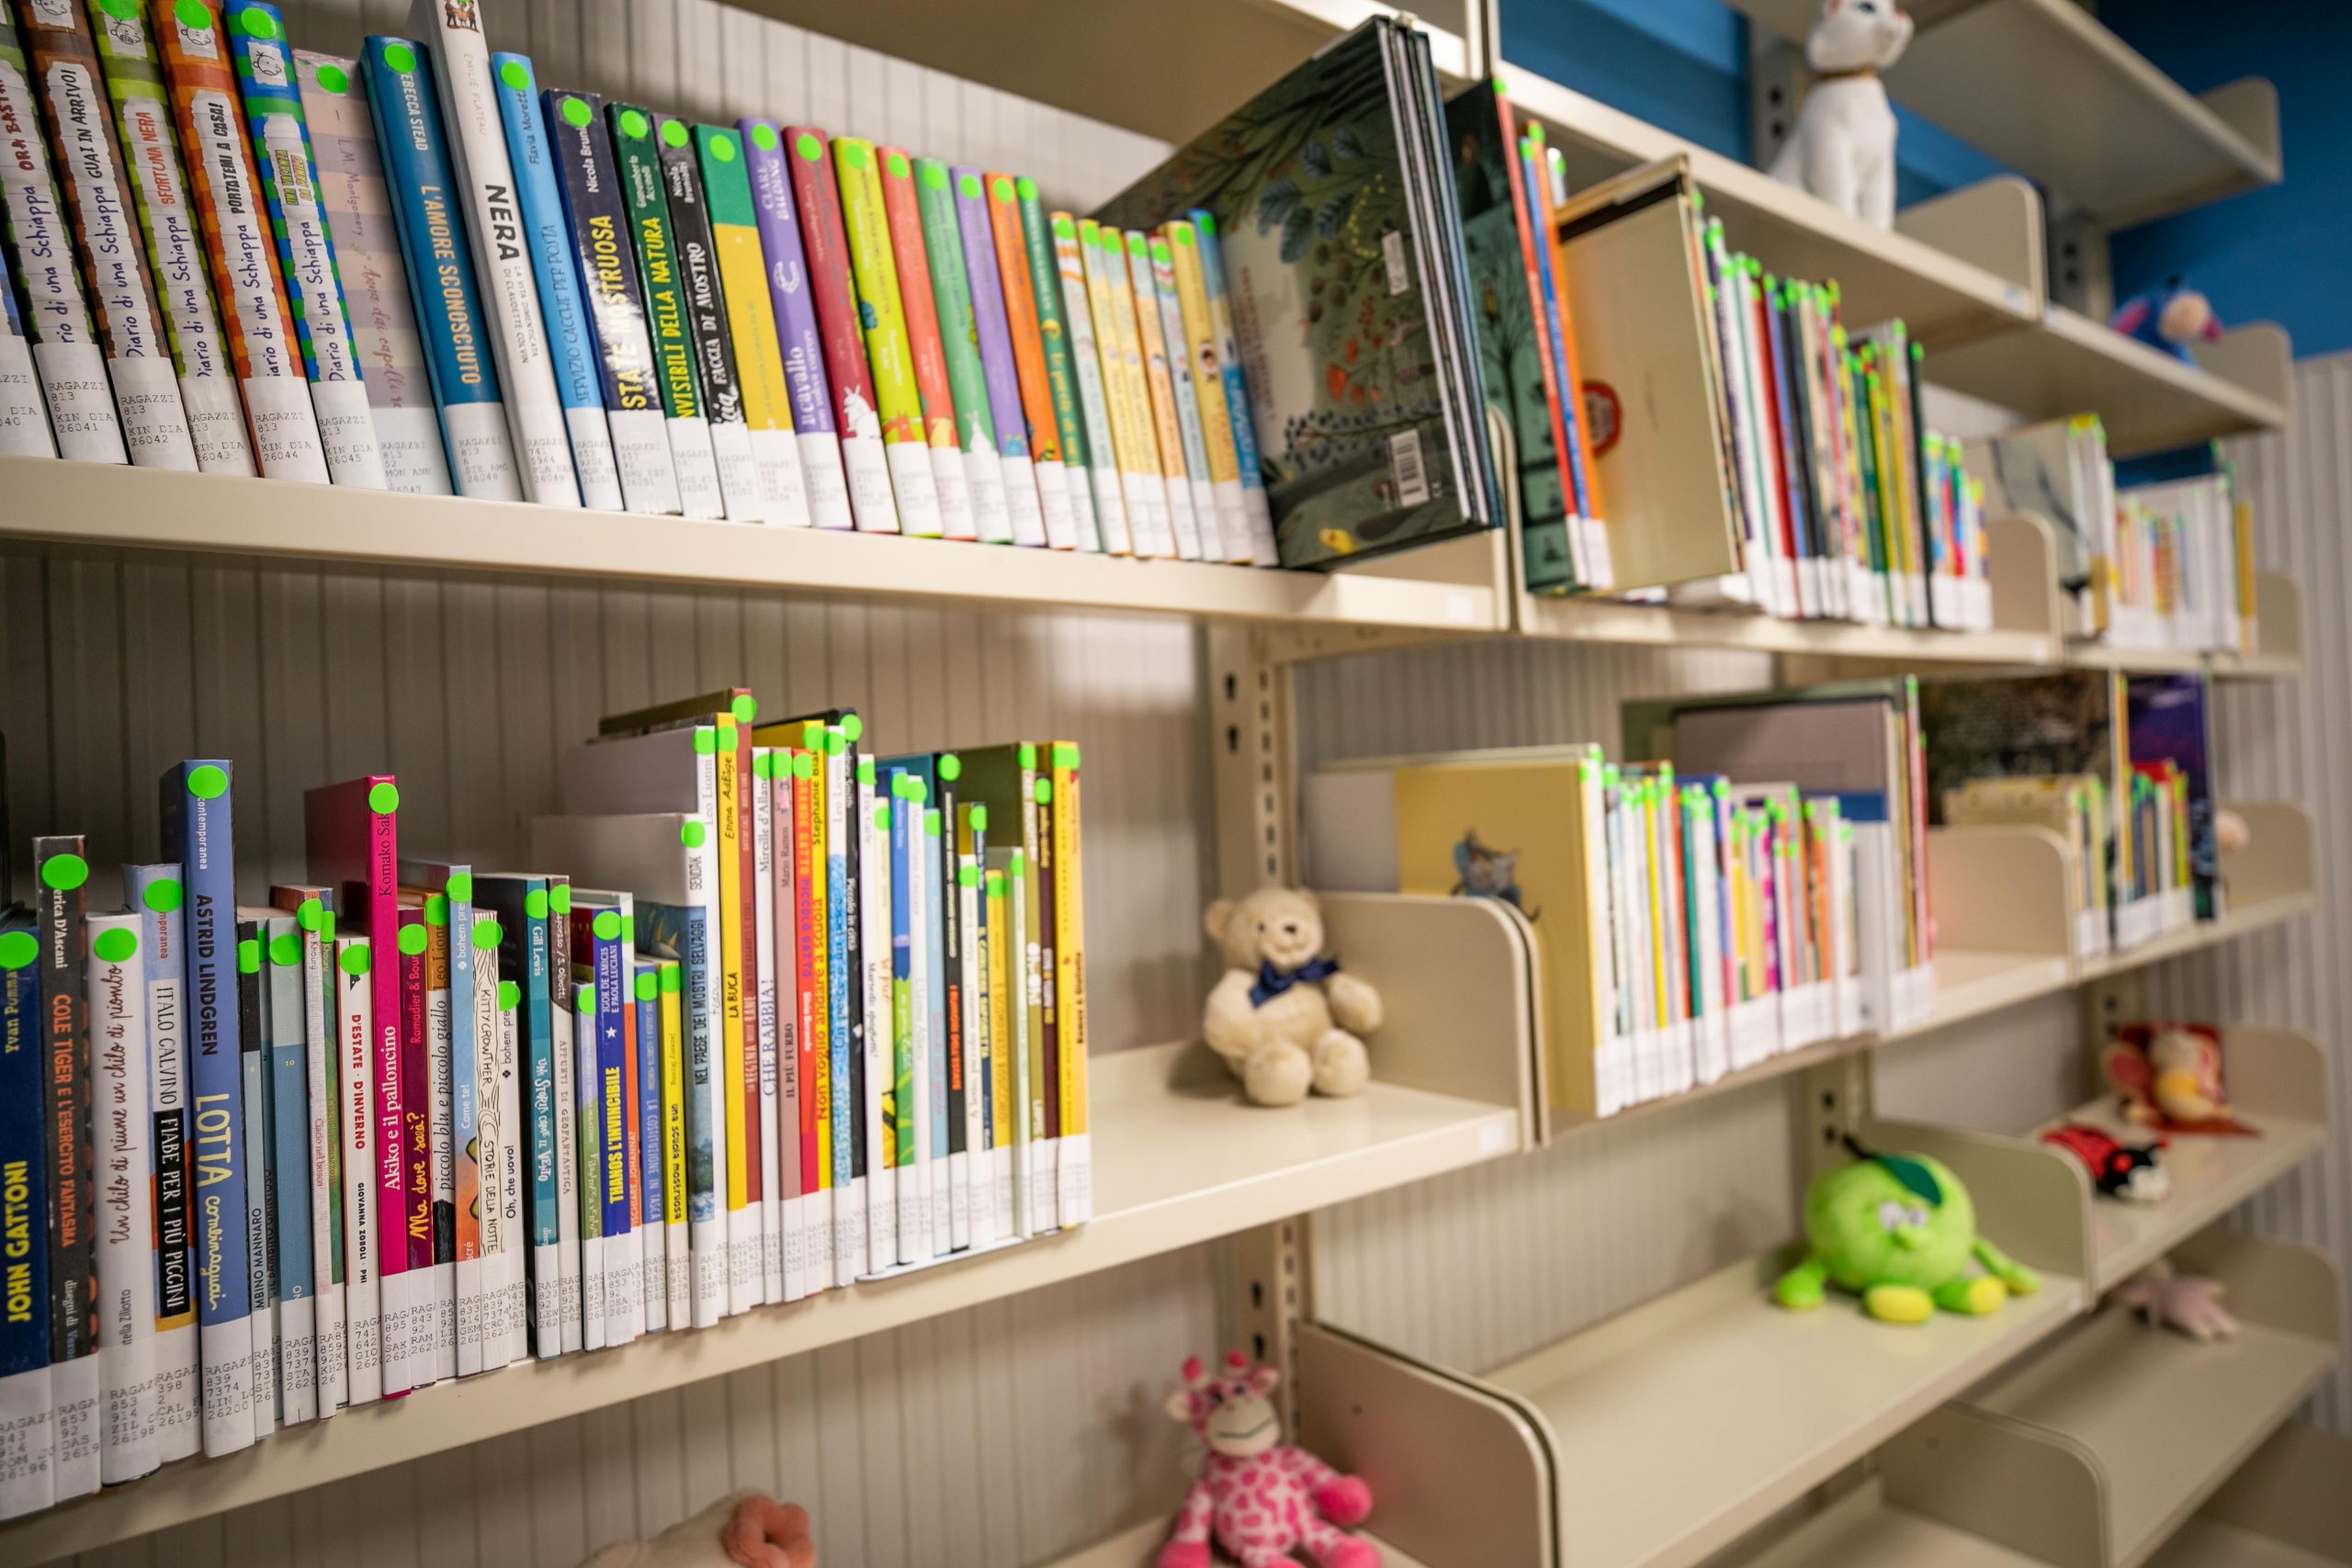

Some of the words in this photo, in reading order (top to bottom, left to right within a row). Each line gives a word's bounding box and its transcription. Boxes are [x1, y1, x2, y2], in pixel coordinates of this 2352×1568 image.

[61, 69, 87, 125] ARRIVO!
[401, 73, 420, 116] EBECCA
[411, 118, 428, 152] STEAD
[76, 129, 93, 143] IN
[136, 111, 158, 142] NERA
[209, 103, 229, 137] CASA!
[11, 139, 35, 171] ORA
[85, 147, 103, 179] GUAI
[217, 142, 231, 151] A
[526, 134, 539, 164] Flavia
[147, 146, 175, 206] SFORTUNA
[219, 153, 245, 214] PORTATEMI
[275, 150, 294, 186] VACANZA
[290, 154, 309, 188] PANICO
[582, 158, 599, 193] Nicola
[283, 187, 300, 206] UNA
[299, 188, 313, 202] DA
[346, 172, 364, 237] Montgomery
[93, 186, 119, 254] Schiappa
[420, 185, 456, 260] L'AMORE
[485, 184, 520, 261] NERA
[167, 216, 191, 281] Schiappa
[301, 221, 322, 285] Schiappa
[542, 224, 562, 265] POSTA
[641, 217, 672, 284] NATURA
[112, 263, 128, 288] una
[550, 268, 568, 291] PER
[589, 215, 634, 334] MOSTRUOSA
[686, 242, 714, 310] MOSTRO
[111, 295, 133, 309] di
[184, 289, 198, 313] una
[317, 292, 330, 316] una
[655, 290, 682, 338] DELLA
[183, 321, 204, 333] di
[316, 323, 335, 335] di
[437, 265, 481, 384] SCONOSCIUTO
[556, 296, 578, 344] CACCHE
[701, 314, 718, 332] DI
[329, 342, 345, 381] Diario
[567, 349, 591, 402] SERVIZIO
[706, 337, 728, 385] FACCIA
[48, 381, 106, 391] RAGAZZI
[786, 346, 815, 412] cavallo
[121, 395, 176, 405] RAGAZZI
[124, 405, 146, 414] 813
[129, 425, 151, 435] KIN
[159, 424, 184, 434] DIA
[254, 412, 305, 423] RAGAZZI
[131, 435, 169, 446] 26042
[265, 451, 300, 462] 26044
[725, 807, 736, 840] Emma
[812, 780, 823, 845] Stephanie
[197, 797, 208, 870] contemporanea
[781, 827, 790, 858] Ramos
[379, 840, 391, 897] Komako
[689, 856, 703, 890] SENDAK
[782, 864, 791, 888] Mario
[197, 894, 216, 959] ASTRID
[532, 926, 544, 945] Gill
[812, 897, 825, 949] scuola
[53, 919, 68, 969] D'Ascani
[457, 924, 466, 958] bohem
[690, 919, 705, 965] SELVAGGI
[533, 948, 544, 977] Lewis
[600, 946, 609, 977] AMICIS
[610, 944, 618, 978] LUCIANI
[814, 956, 824, 965] a
[100, 964, 132, 1020] piombo
[601, 995, 610, 1012] IGOR
[602, 982, 610, 992] DE
[610, 980, 619, 1005] PAOLA
[692, 970, 707, 1010] MOSTRI
[728, 972, 738, 1004] BUCA
[814, 967, 825, 1027] andare
[52, 994, 73, 1034] COLE
[156, 987, 175, 1031] ITALO
[198, 964, 218, 1055] LINDGREN
[409, 994, 422, 1044] Ramadier
[431, 999, 451, 1040] giallo
[694, 1013, 707, 1030] DEI
[729, 1005, 739, 1019] LA
[762, 979, 775, 1054] RABBIA!
[5, 1019, 20, 1054] Yvan
[107, 1024, 124, 1039] di
[351, 1014, 364, 1069] D'ESTATE
[502, 1032, 511, 1064] bohem
[785, 1022, 795, 1055] FURBO
[53, 1039, 73, 1085] TIGER
[103, 1043, 126, 1079] chilo
[560, 1040, 568, 1089] APPUNTI
[694, 1034, 707, 1065] PAESE
[815, 1028, 830, 1085] voglio
[158, 1038, 177, 1105] CALVINO
[381, 1025, 401, 1112] palloncino
[432, 1045, 453, 1095] piccolo
[695, 1066, 708, 1085] NEL
[763, 1058, 777, 1097] CHE
[58, 1088, 72, 1097] E
[112, 1083, 126, 1104] un
[439, 1100, 448, 1109] e
[460, 1083, 469, 1098] te!
[561, 1091, 568, 1102] DI
[786, 1088, 796, 1099] IL
[817, 1089, 828, 1121] Non
[353, 1081, 366, 1150] D'INVERNO
[382, 1113, 399, 1127] il
[433, 1113, 448, 1137] blu
[461, 1100, 470, 1130] Come
[605, 1066, 623, 1150] L'INVINCIBILE
[58, 1100, 74, 1176] L'ESERCITO
[110, 1108, 138, 1153] piume
[160, 1117, 179, 1164] FIABE
[196, 1093, 232, 1188] LOTTA
[388, 1130, 399, 1140] e
[406, 1112, 425, 1154] sarà?
[672, 1125, 680, 1161] scuola
[110, 1156, 129, 1171] di
[384, 1145, 401, 1190] Akiko
[434, 1139, 454, 1190] piccolo
[504, 1145, 514, 1174] uovo!
[561, 1109, 571, 1195] GEOFANTASTICA
[107, 1174, 130, 1212] chilo
[163, 1170, 181, 1202] PER
[412, 1160, 425, 1194] dove
[505, 1179, 514, 1195] che
[608, 1149, 624, 1204] THANOS
[673, 1164, 682, 1220] mostruosa
[4, 1160, 30, 1258] GATTONI
[60, 1179, 76, 1248] FANTASIA
[357, 1182, 366, 1226] GIOVANNA
[486, 1186, 495, 1214] DELLA
[506, 1198, 516, 1219] Oh,
[109, 1215, 130, 1245] Un
[164, 1218, 187, 1245] PIÙ
[409, 1200, 429, 1240] Ma
[487, 1218, 498, 1253] NOTTE
[252, 1208, 264, 1267] MANNARO
[358, 1229, 367, 1260] ZOBOLI
[6, 1263, 32, 1323] JOHN
[165, 1252, 184, 1308] PICCINI
[62, 1280, 78, 1318] disegni
[119, 1289, 131, 1323] Ziliotto
[66, 1317, 78, 1328] di
[207, 1375, 232, 1387] 839
[207, 1382, 239, 1397] 7374
[208, 1395, 232, 1409] LIN
[208, 1402, 249, 1420] 26200
